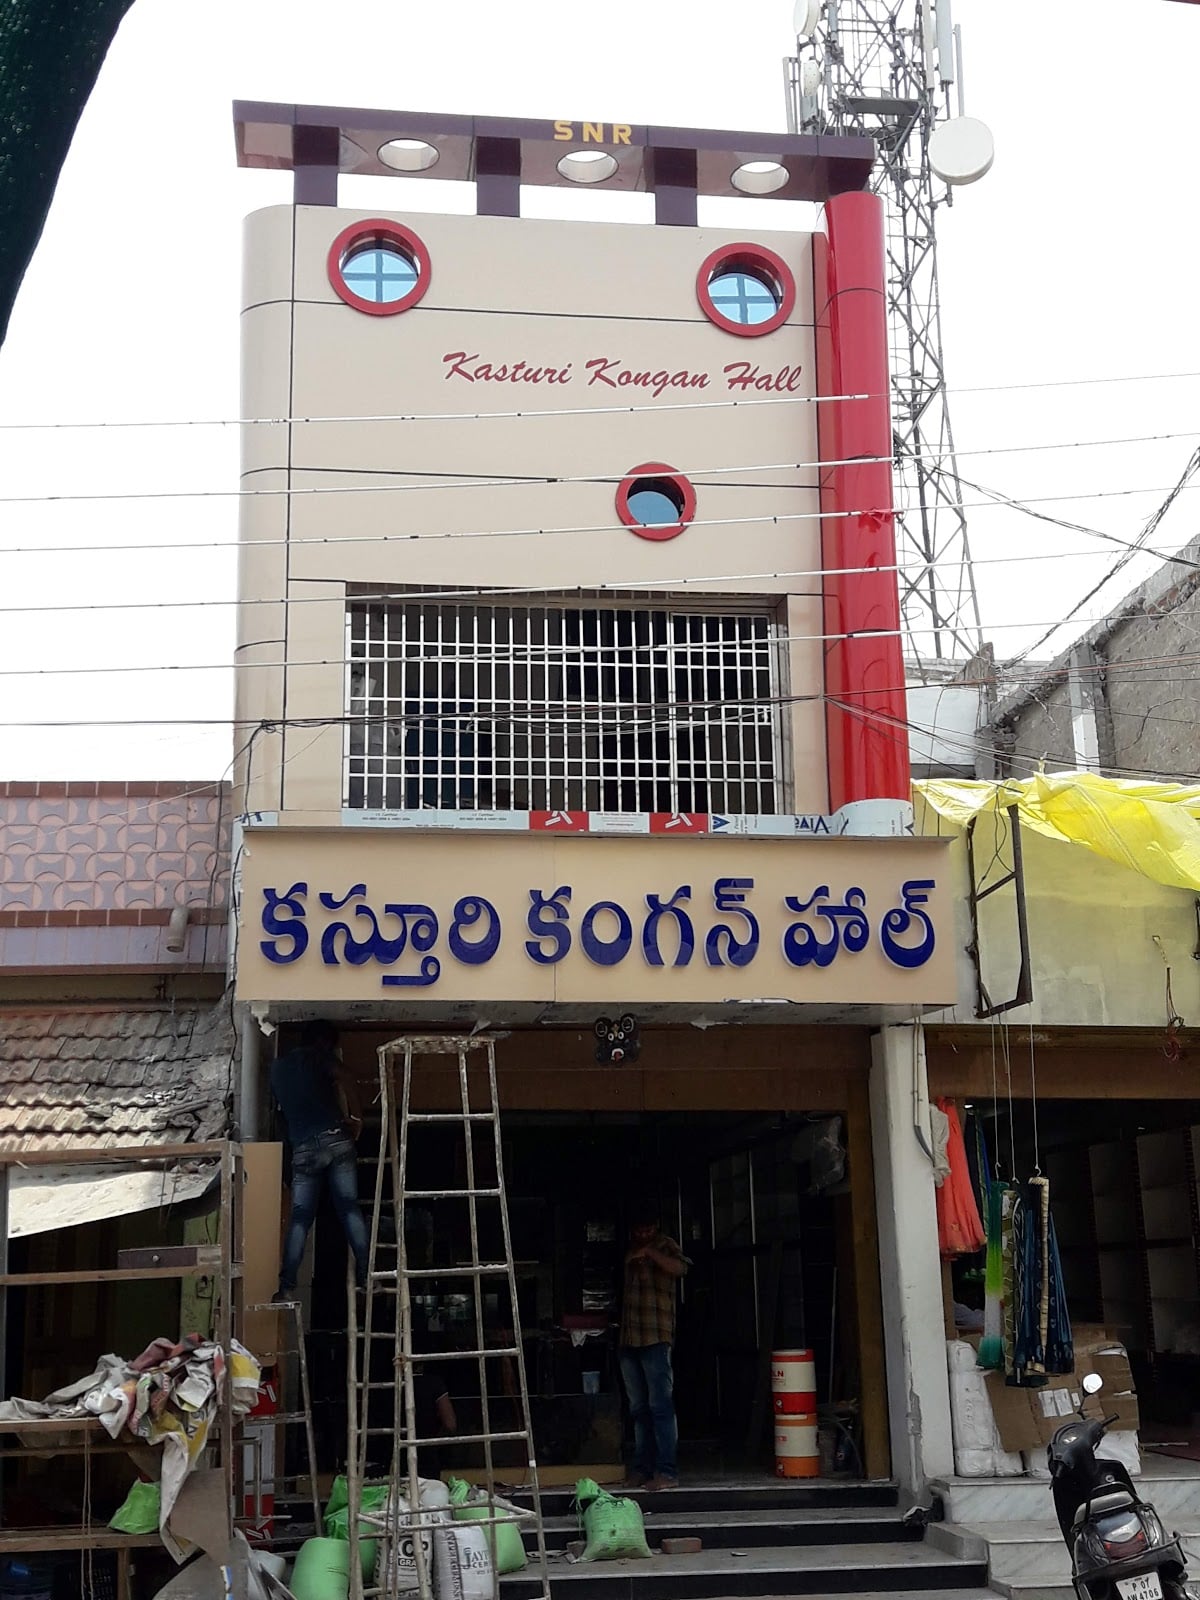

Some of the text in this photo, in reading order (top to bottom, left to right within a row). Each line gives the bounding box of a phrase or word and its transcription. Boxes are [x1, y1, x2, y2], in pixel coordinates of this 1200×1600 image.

[553, 120, 632, 145] SNR
[443, 351, 802, 397] Kasturi Kongan Hall
[261, 877, 936, 987] కస్తూరి కంగన్ హాల్
